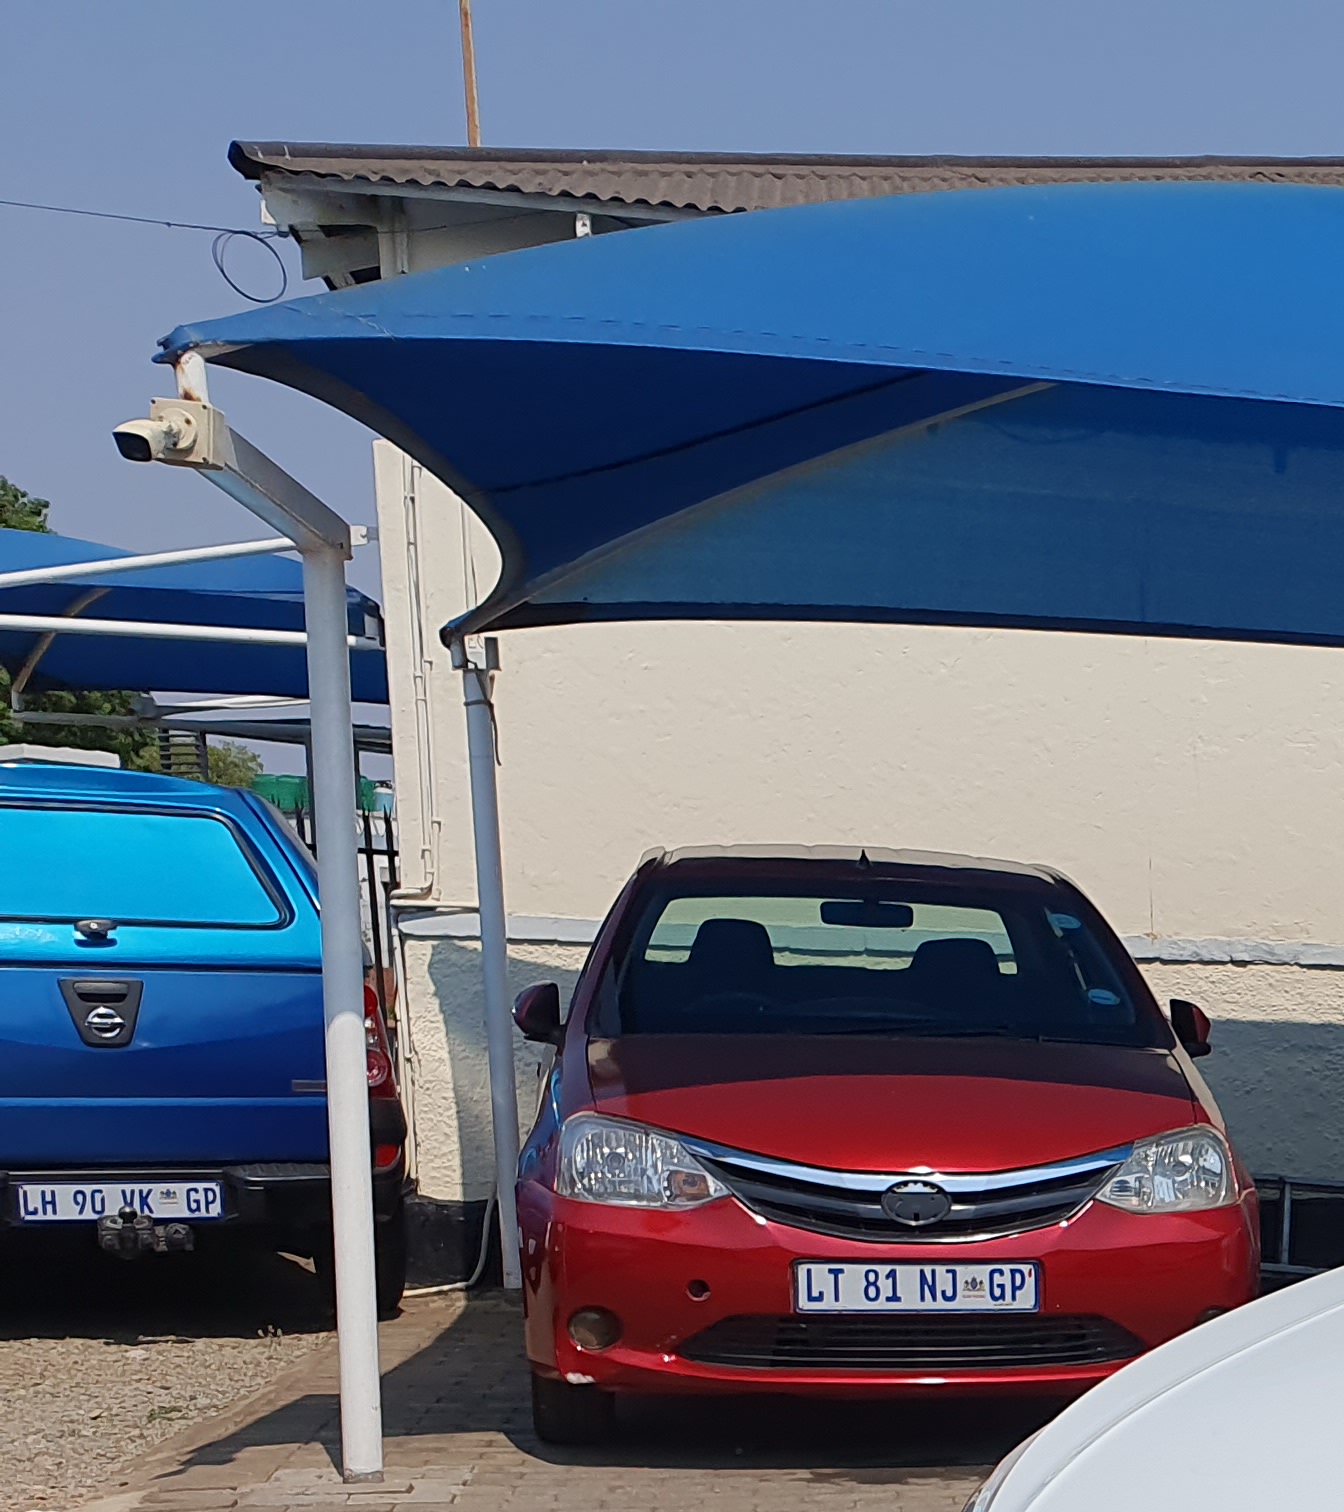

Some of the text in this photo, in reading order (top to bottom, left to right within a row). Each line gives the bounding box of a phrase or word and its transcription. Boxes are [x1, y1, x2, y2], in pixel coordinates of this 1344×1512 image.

[23, 1187, 217, 1216] LH 90 VK GP
[806, 1268, 1026, 1302] LT 81 NJ GP
